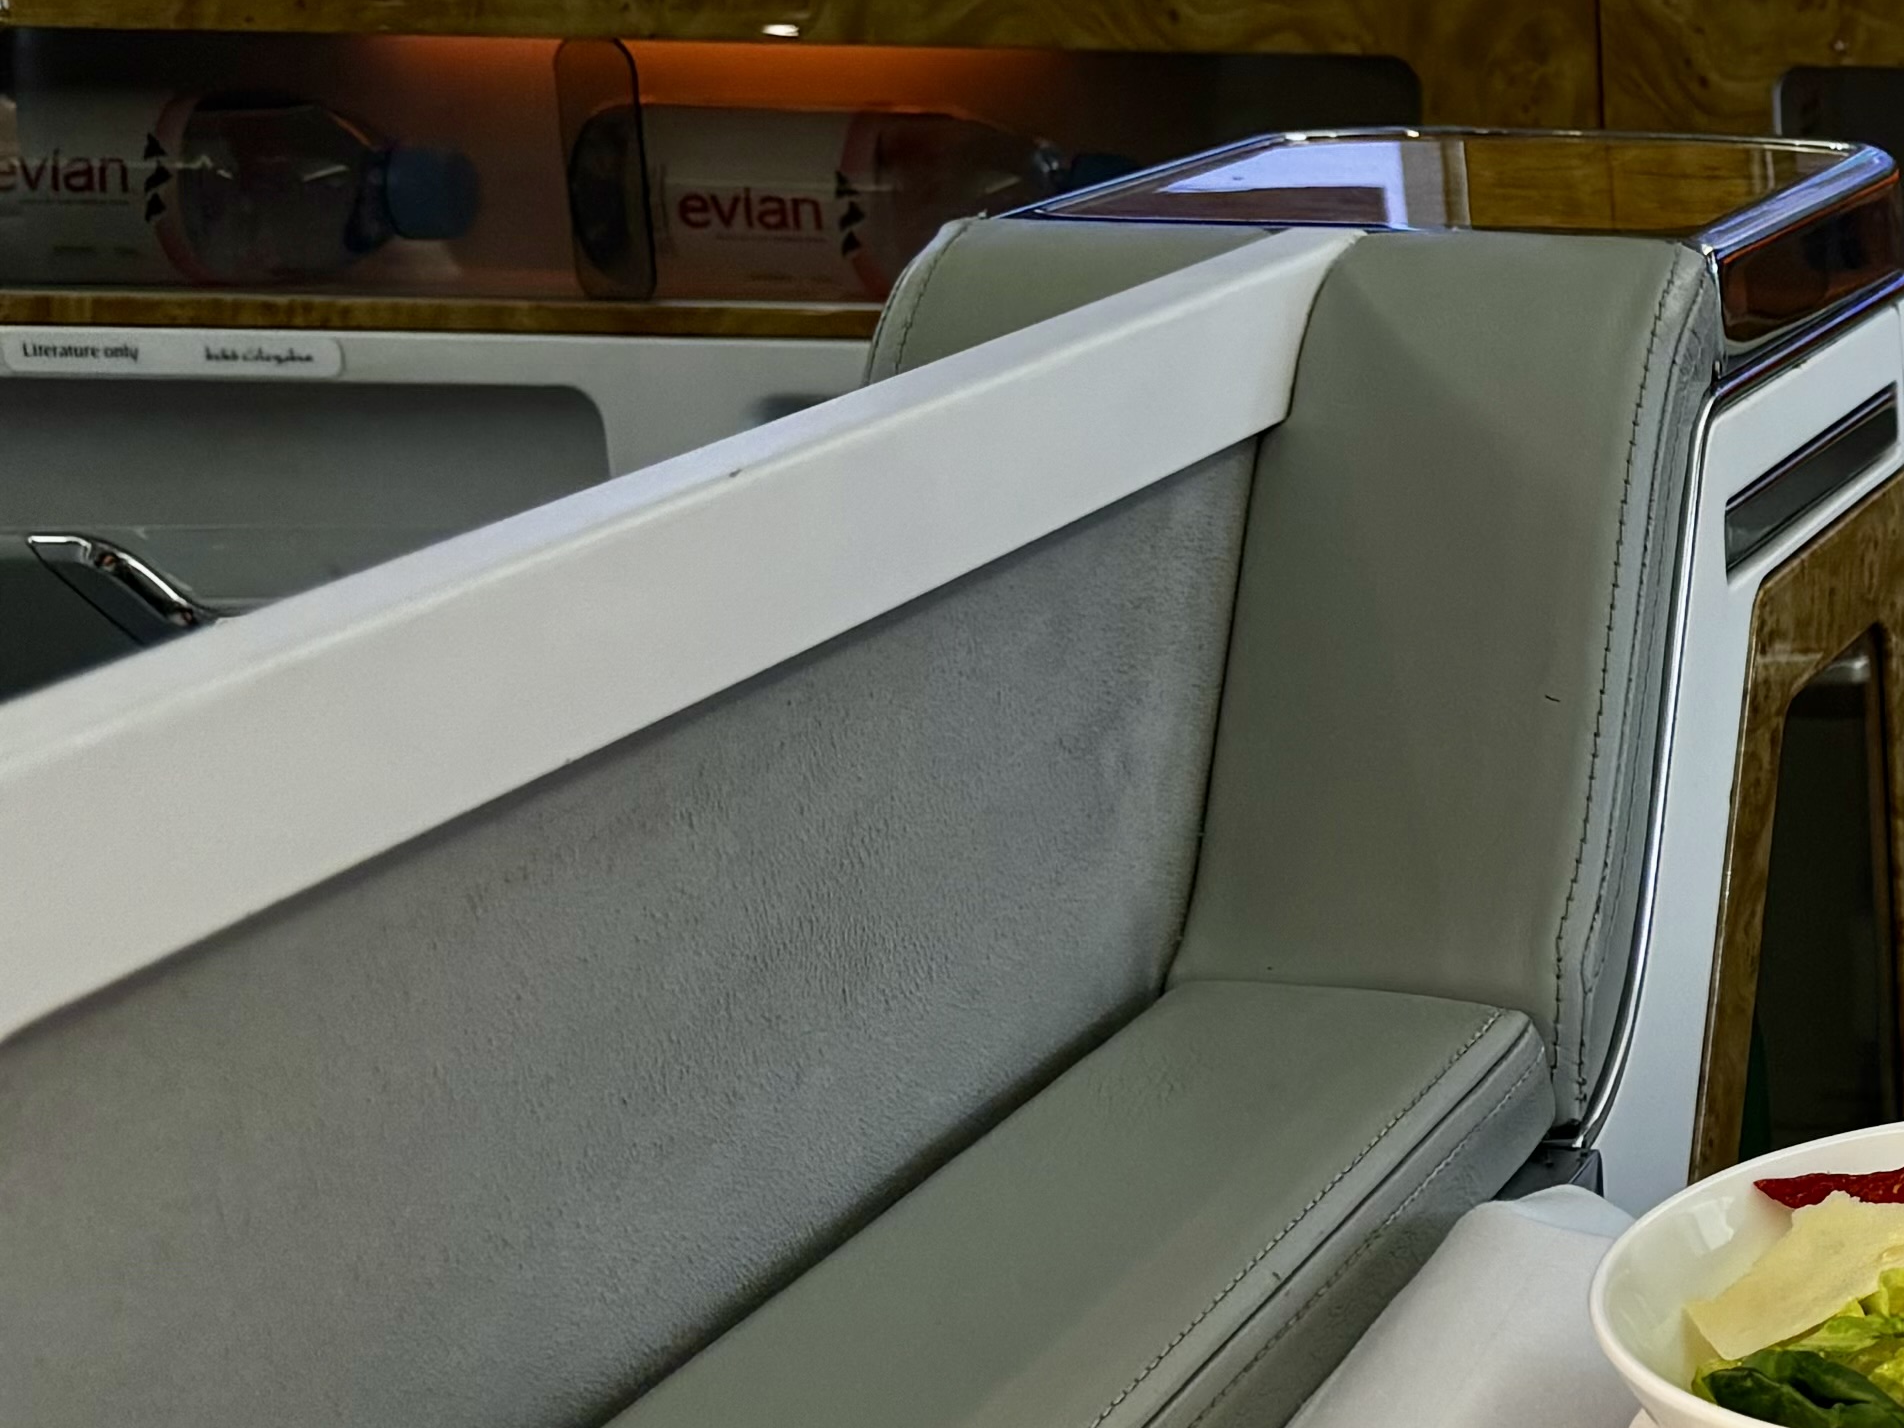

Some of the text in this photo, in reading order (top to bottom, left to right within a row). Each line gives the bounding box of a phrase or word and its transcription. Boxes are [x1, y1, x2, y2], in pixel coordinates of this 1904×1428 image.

[677, 187, 822, 231] evian
[23, 343, 139, 362] Literature only
